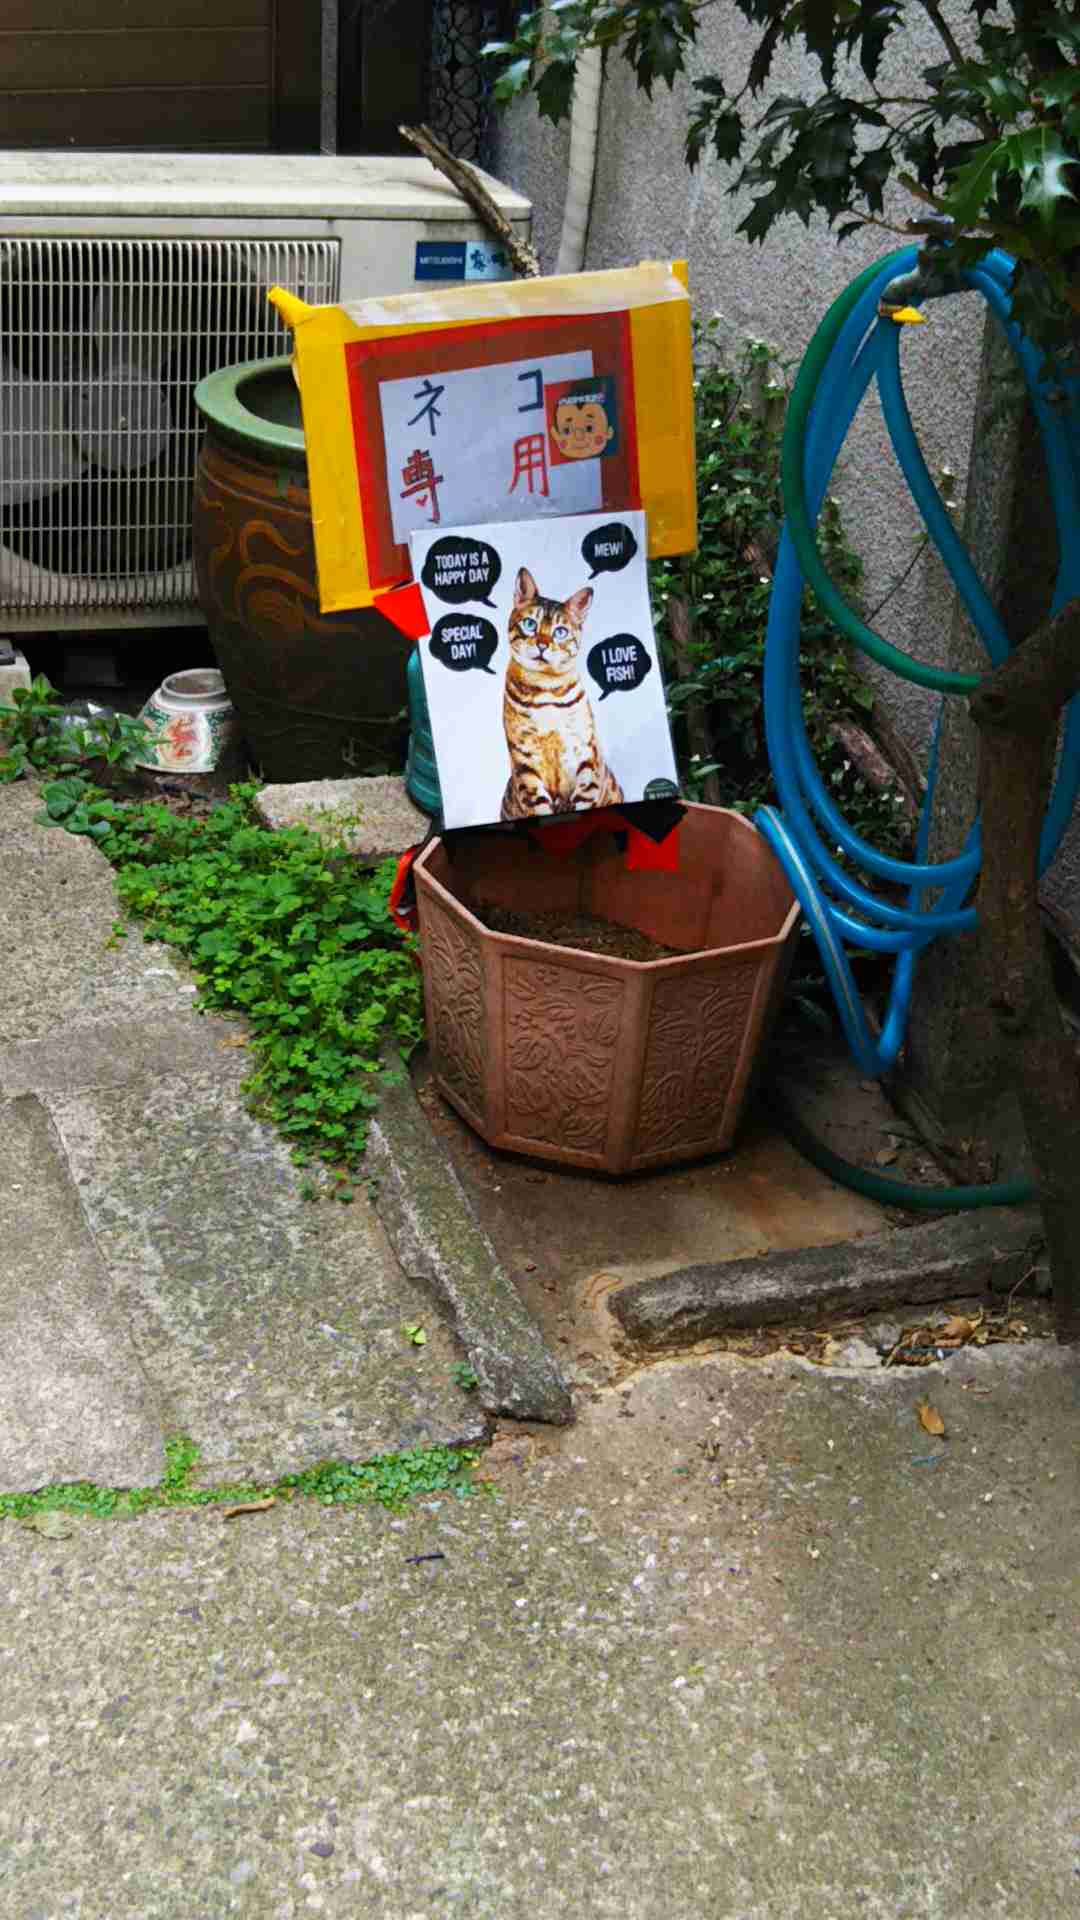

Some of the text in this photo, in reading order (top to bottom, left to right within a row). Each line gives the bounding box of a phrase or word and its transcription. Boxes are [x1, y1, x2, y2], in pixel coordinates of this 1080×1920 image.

[593, 541, 624, 558] MEW!
[434, 550, 490, 569] TODAY IS A
[434, 567, 490, 586] HAPPY DAY
[441, 624, 484, 643] SPECIAL
[450, 642, 477, 660] DAY!
[601, 645, 638, 665] I LOVE
[605, 664, 636, 682] FISH!
